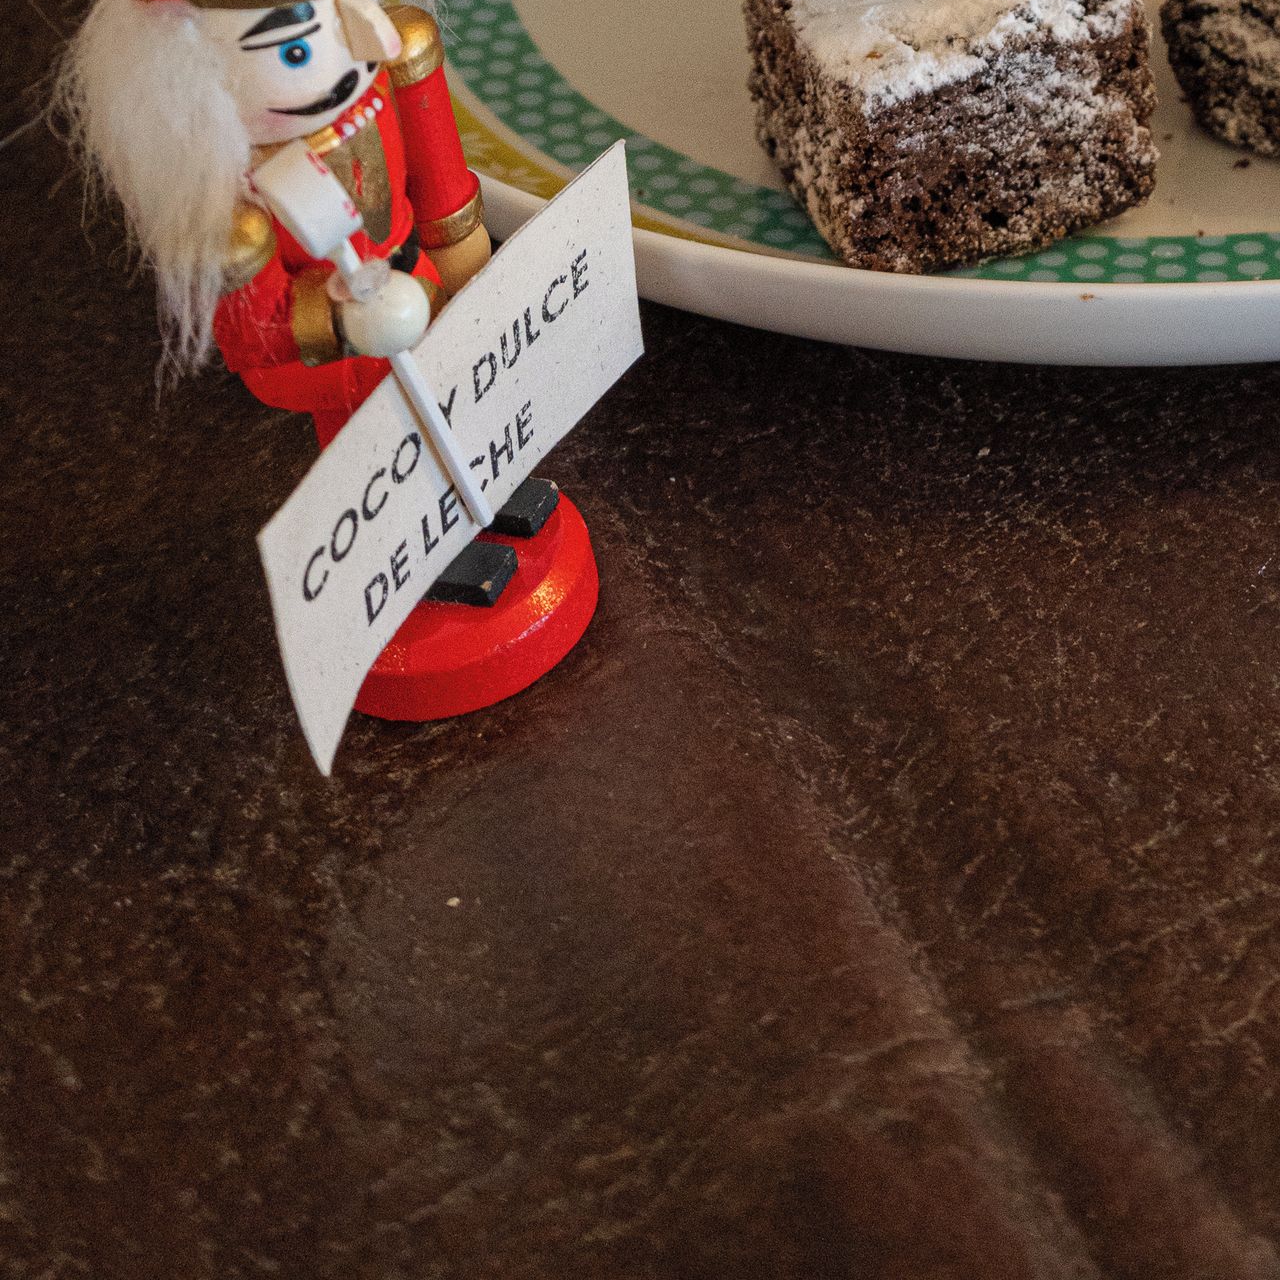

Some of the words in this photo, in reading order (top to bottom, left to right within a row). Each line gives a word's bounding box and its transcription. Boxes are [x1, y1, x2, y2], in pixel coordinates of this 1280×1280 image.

[303, 432, 421, 602] COCO
[474, 249, 590, 403] DULCE
[364, 538, 411, 627] DE
